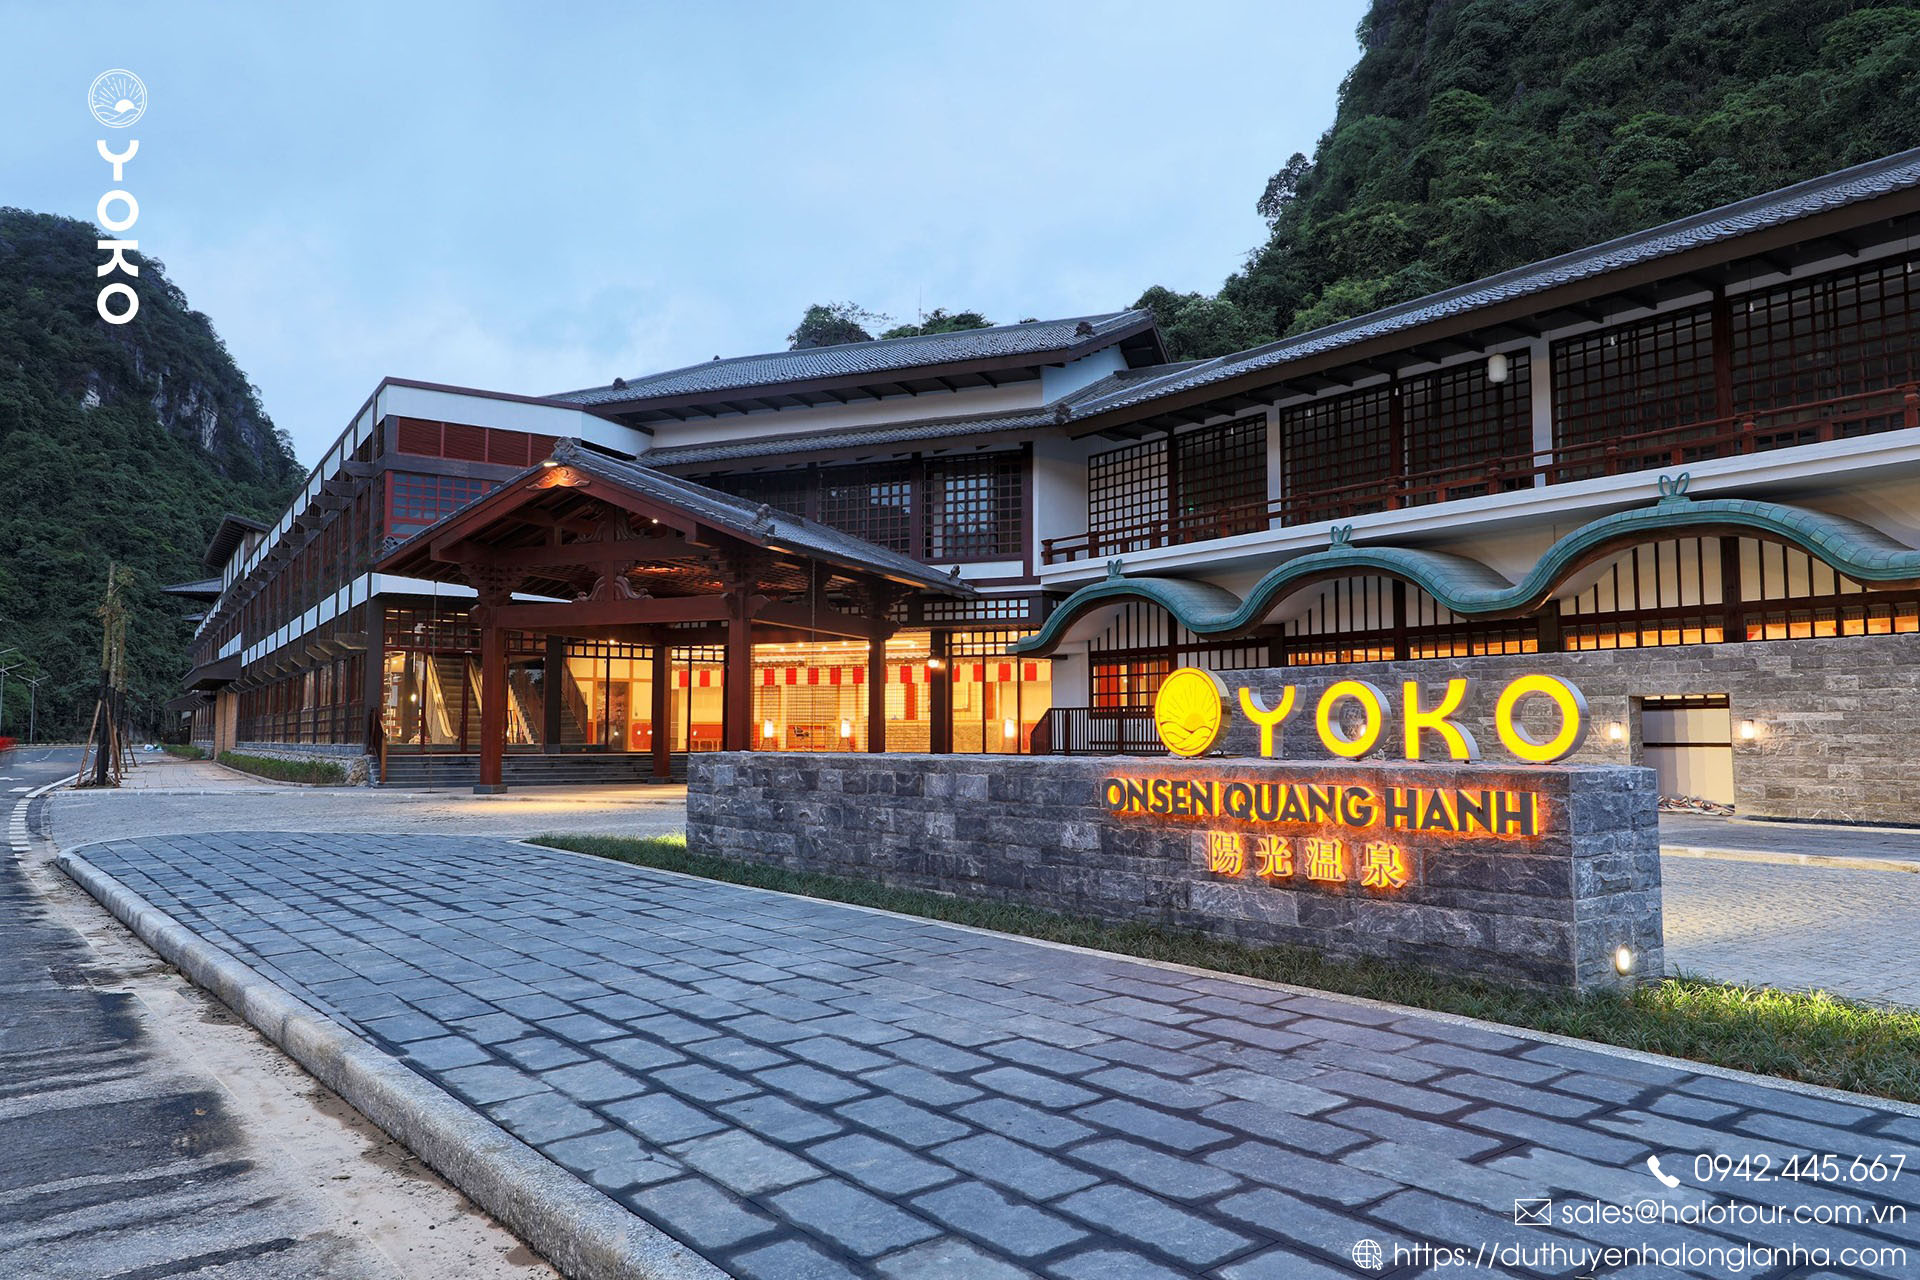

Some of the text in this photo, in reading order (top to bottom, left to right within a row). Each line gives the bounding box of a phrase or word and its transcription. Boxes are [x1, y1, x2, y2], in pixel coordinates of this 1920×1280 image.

[1238, 673, 1587, 763] YOKO
[1104, 776, 1541, 837] ONSEN QUANG HANH
